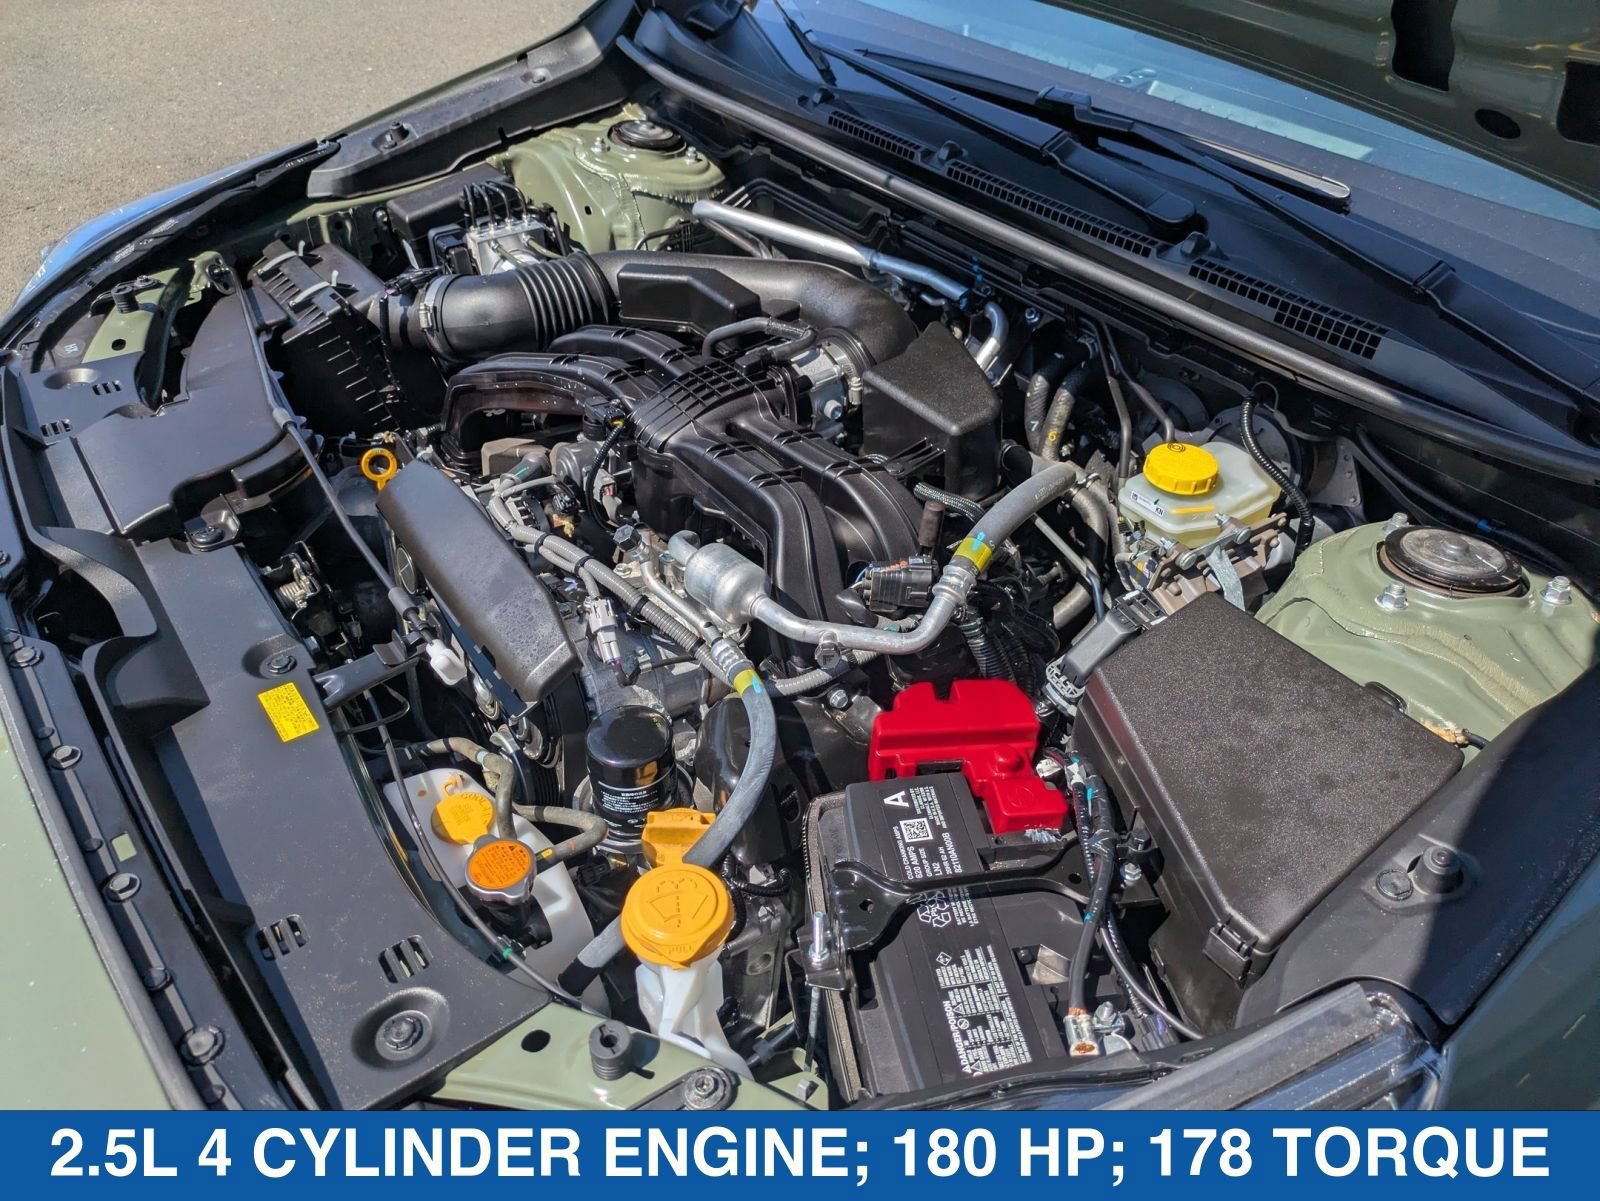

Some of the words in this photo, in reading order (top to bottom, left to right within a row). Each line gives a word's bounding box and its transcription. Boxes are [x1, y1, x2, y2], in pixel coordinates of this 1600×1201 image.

[1030, 420, 1039, 432] 7
[884, 790, 910, 808] A
[893, 826, 901, 839] AMPS
[897, 840, 909, 865] CRANKING
[907, 846, 919, 865] AMPS
[905, 866, 913, 879] COLD
[922, 859, 932, 877] GROUP
[932, 863, 942, 875] LN2
[942, 1000, 968, 1065] DANGER/POISON
